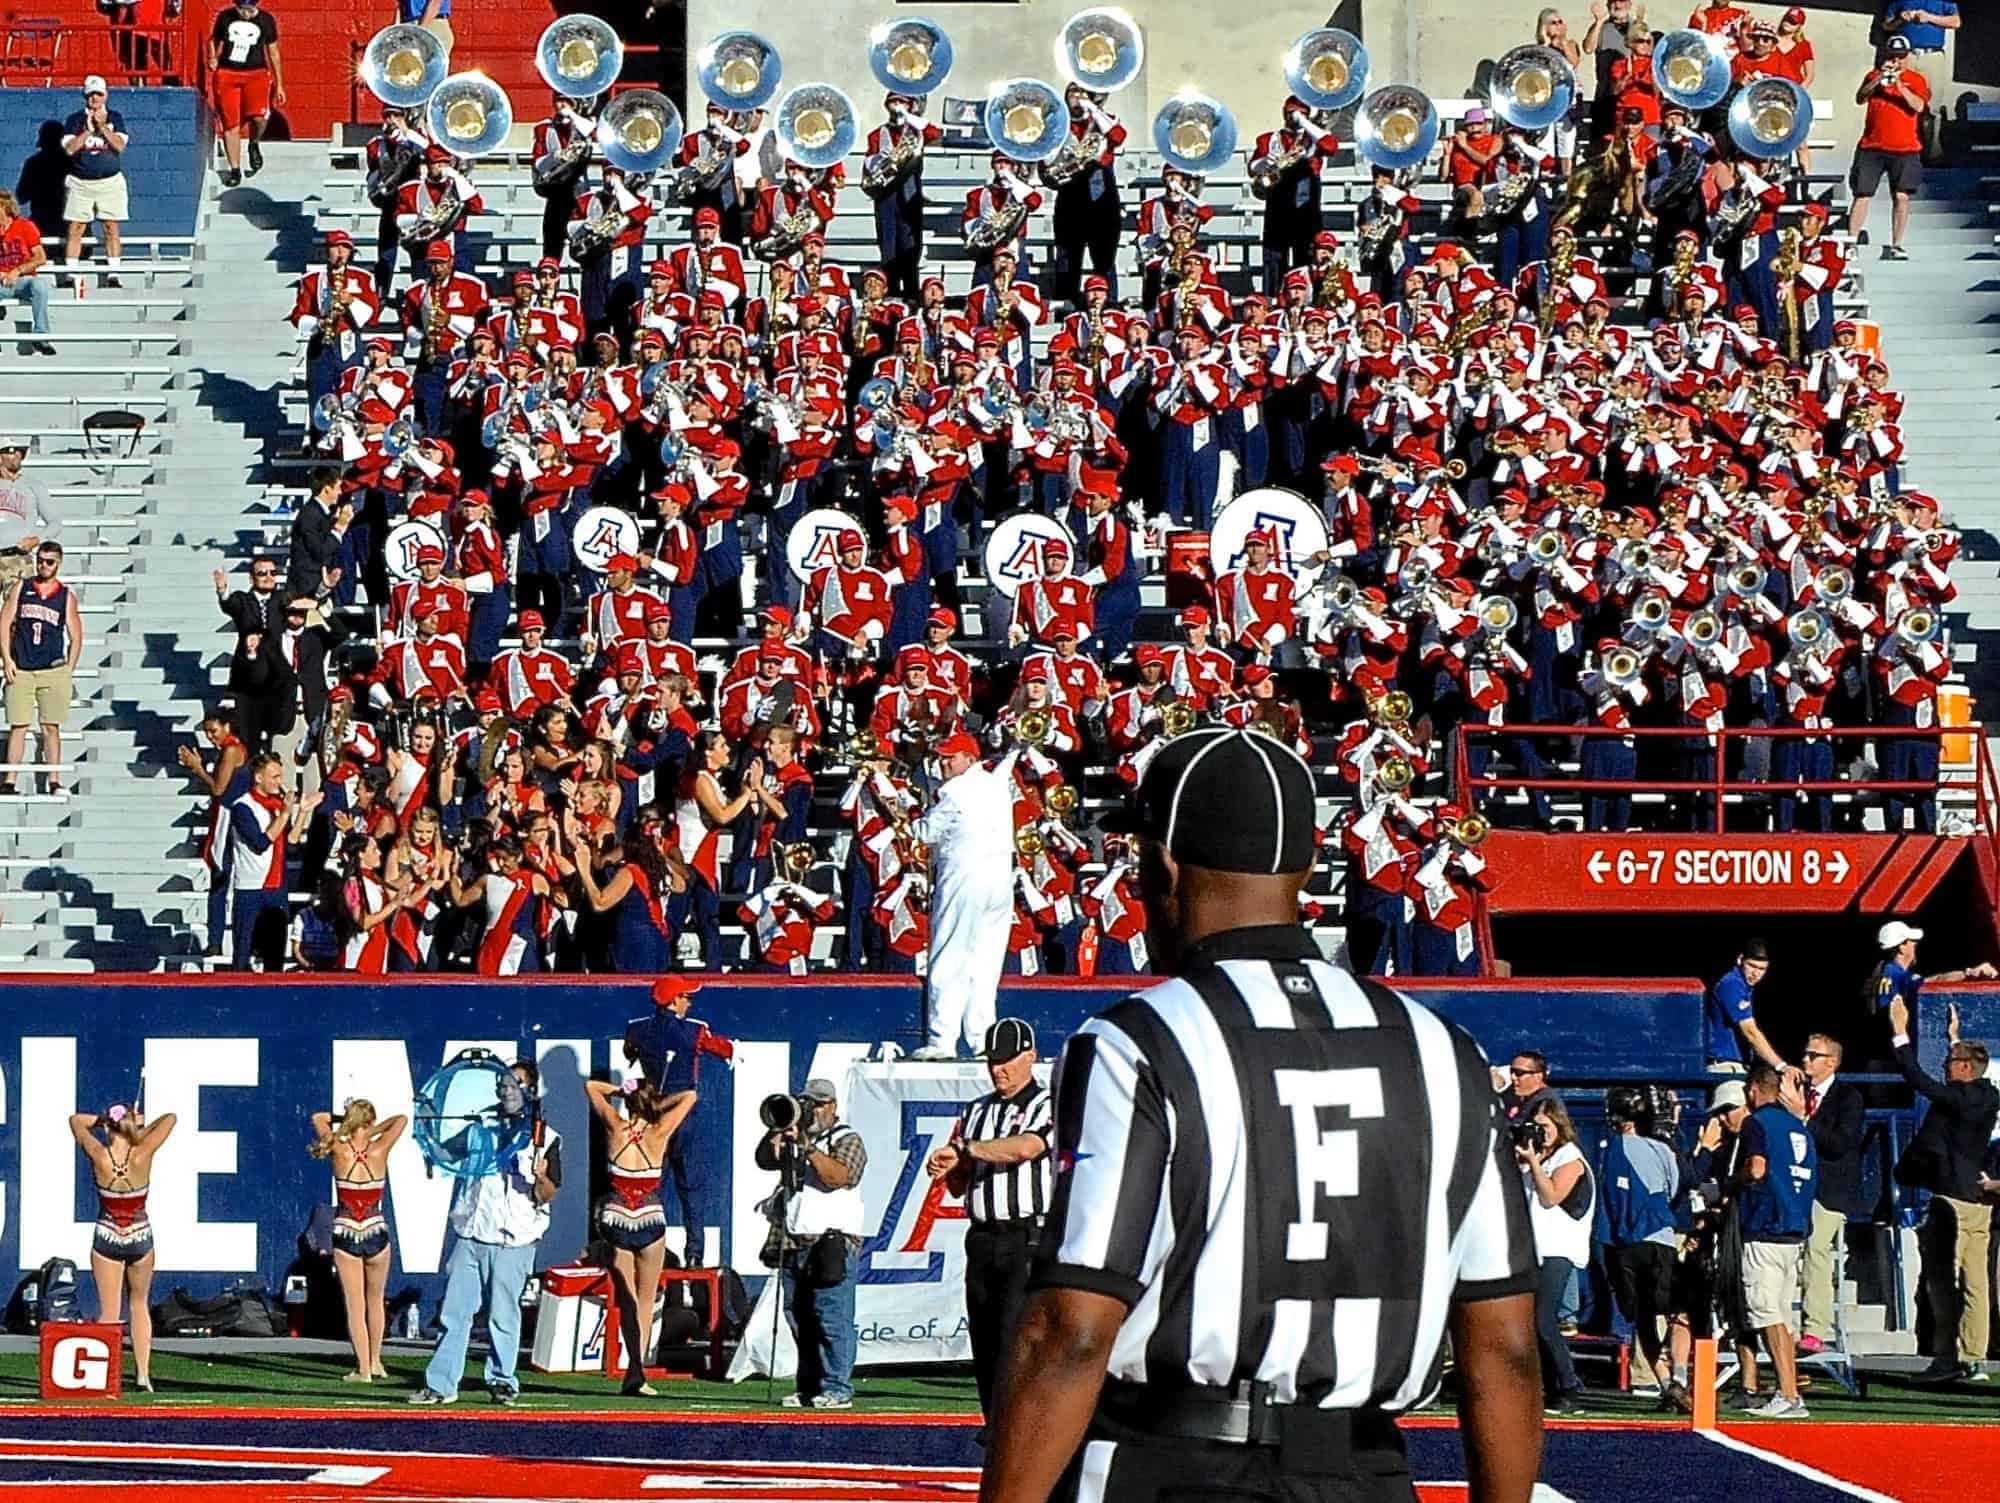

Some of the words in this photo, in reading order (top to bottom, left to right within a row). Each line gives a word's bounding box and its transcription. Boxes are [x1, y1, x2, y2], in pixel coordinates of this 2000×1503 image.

[582, 518, 622, 558] A
[802, 526, 843, 569] A
[999, 530, 1049, 578] A
[32, 622, 42, 645] 1
[1617, 850, 1665, 884] 6-7
[1674, 849, 1792, 884] SECTION
[1802, 849, 1820, 884] 8
[0, 1037, 259, 1272] LE
[1273, 1067, 1385, 1261] F
[908, 1317, 938, 1339] of
[52, 1337, 109, 1390] G
